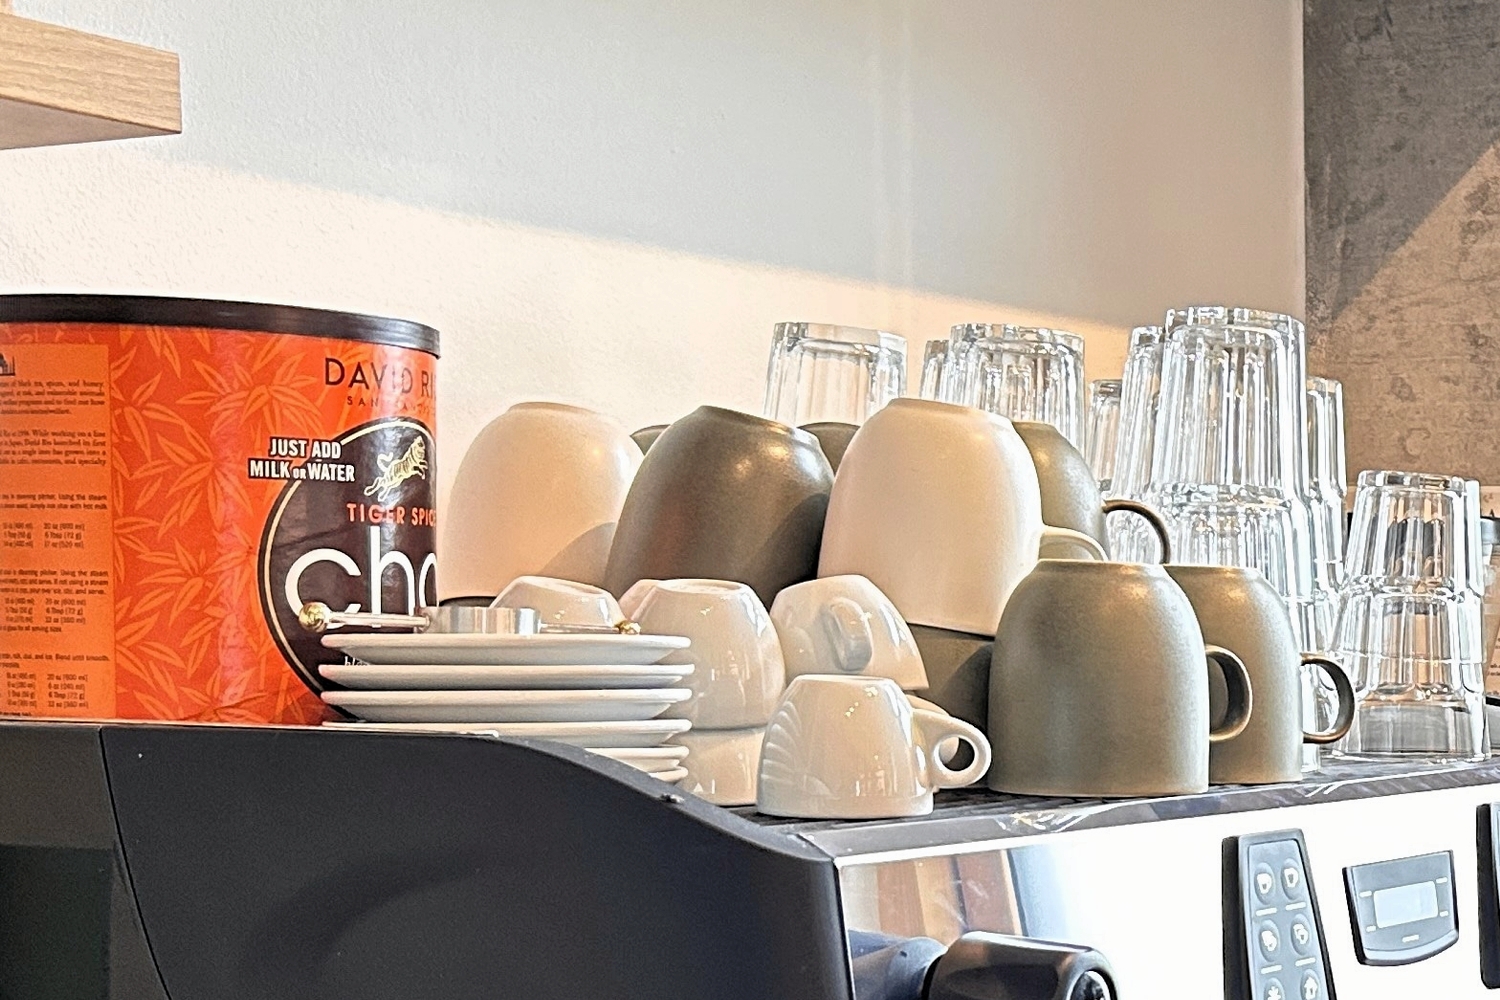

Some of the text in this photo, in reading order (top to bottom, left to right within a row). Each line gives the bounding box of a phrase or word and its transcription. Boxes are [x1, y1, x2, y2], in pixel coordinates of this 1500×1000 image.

[325, 357, 436, 399] DAVID RI
[347, 396, 379, 408] SAN
[270, 439, 341, 459] JUST ADD
[250, 460, 290, 478] MILK
[307, 462, 355, 482] WATER
[346, 503, 436, 526] TIGER SPIC
